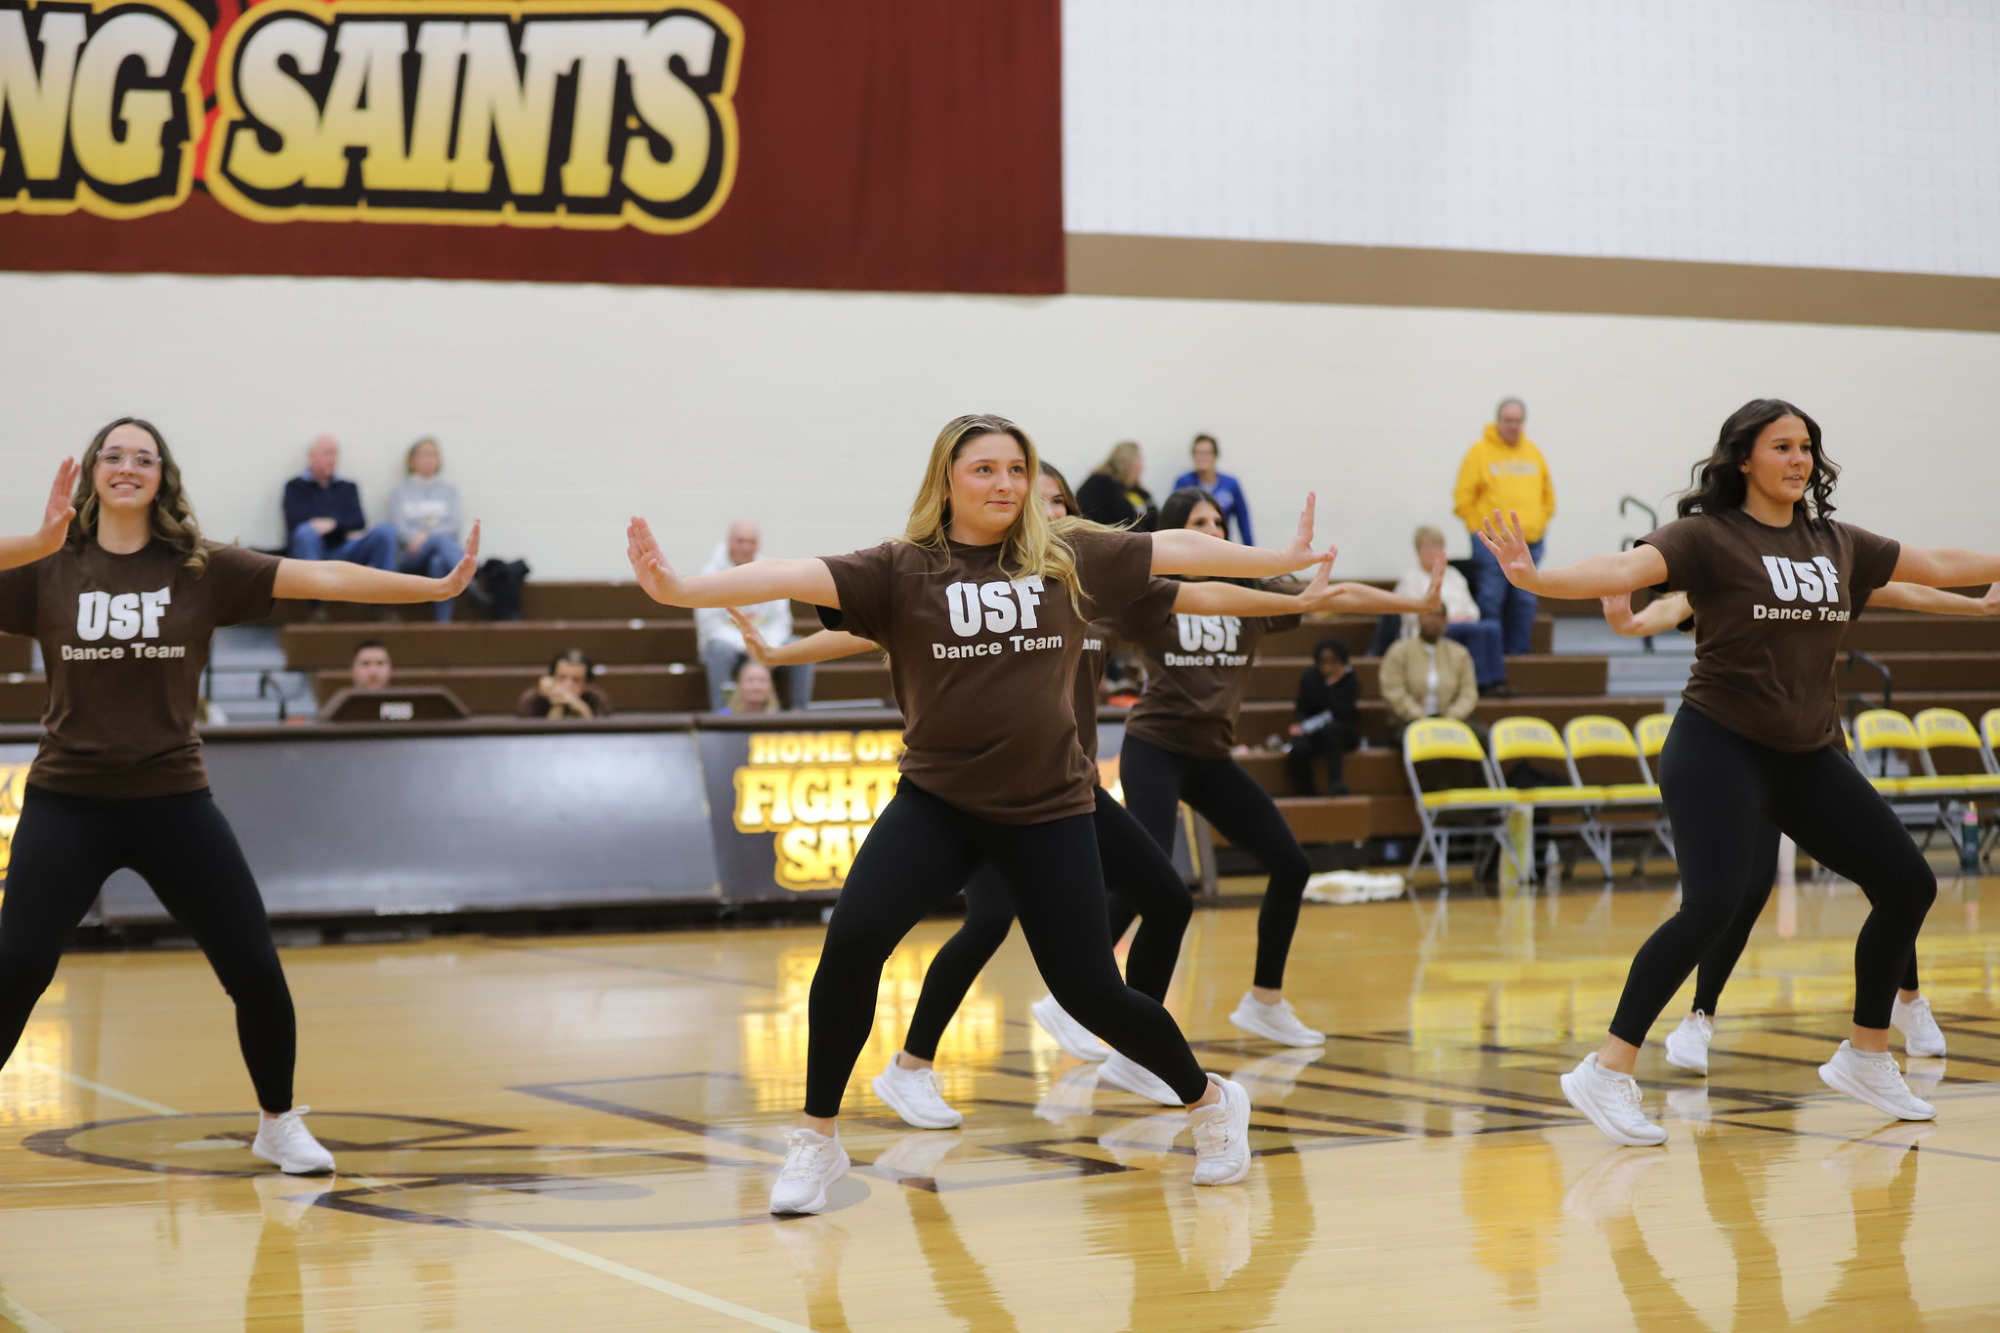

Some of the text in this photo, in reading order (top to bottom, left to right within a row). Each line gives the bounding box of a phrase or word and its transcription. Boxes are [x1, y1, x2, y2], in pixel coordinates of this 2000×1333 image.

[224, 14, 718, 203] SAINTS
[1762, 555, 1839, 603] USF
[77, 586, 171, 641] USF
[945, 574, 1044, 638] USF
[1753, 604, 1812, 621] Dance
[932, 634, 1063, 660] Dance Team
[1082, 638, 1102, 651] am
[1176, 613, 1242, 652] USF
[61, 642, 186, 661] Dance Team
[1164, 652, 1214, 667] Dance
[750, 733, 852, 764] HOME
